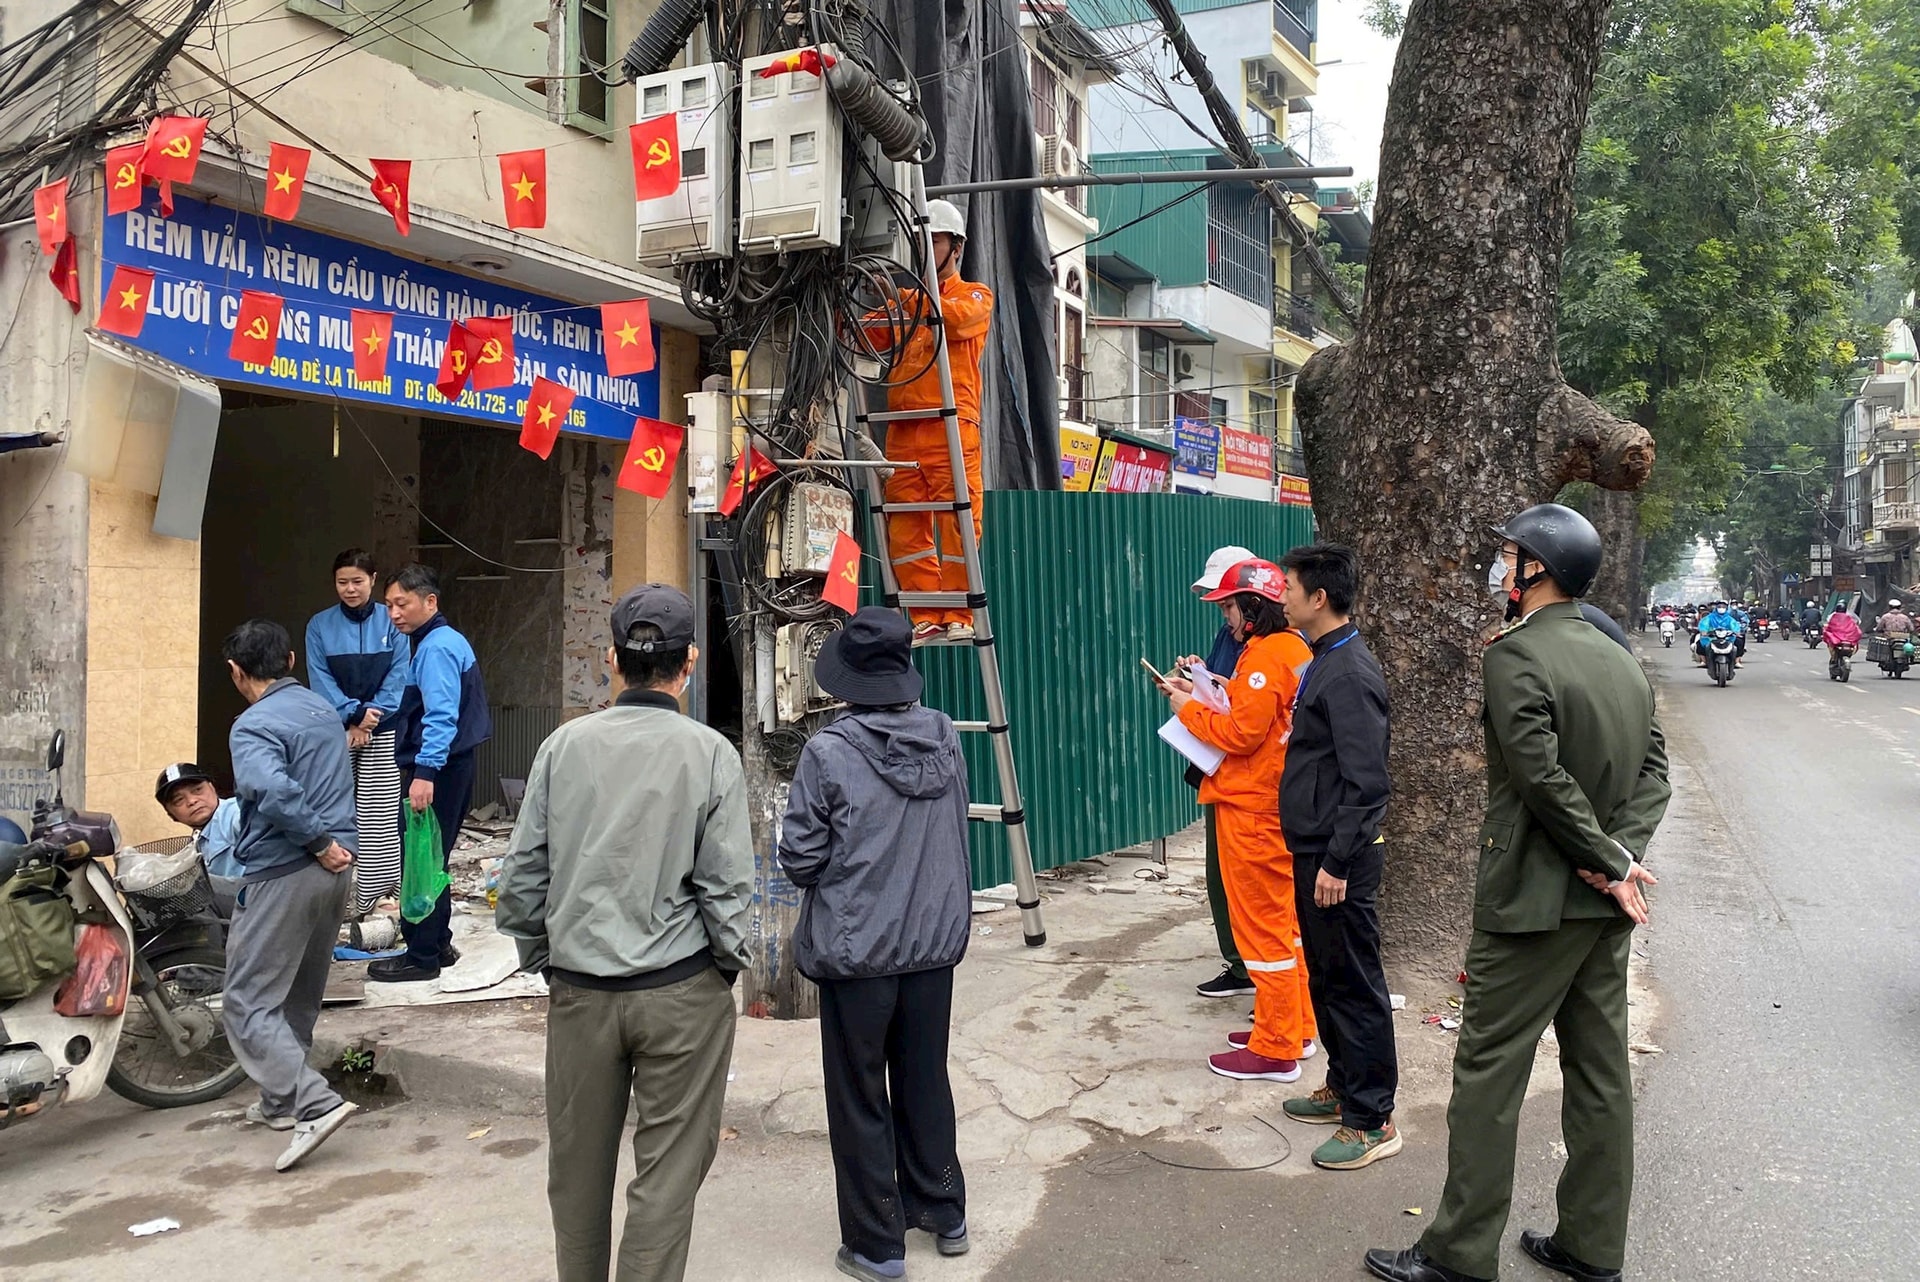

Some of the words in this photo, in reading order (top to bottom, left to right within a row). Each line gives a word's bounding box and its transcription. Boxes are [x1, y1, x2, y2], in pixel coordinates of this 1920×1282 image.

[126, 208, 192, 260] RÈM
[201, 224, 254, 279] VẢI,
[263, 243, 320, 290] RÈM
[327, 256, 375, 302] CẦU
[381, 269, 440, 317] VỒNG
[446, 289, 488, 323] HÀN
[553, 316, 590, 353] RÈM
[146, 279, 211, 325] LƯỚI
[557, 362, 592, 398] SÀN
[596, 375, 640, 412] NHỰA
[270, 355, 298, 380] 904
[325, 364, 343, 388] LA
[404, 378, 424, 401] ĐT:
